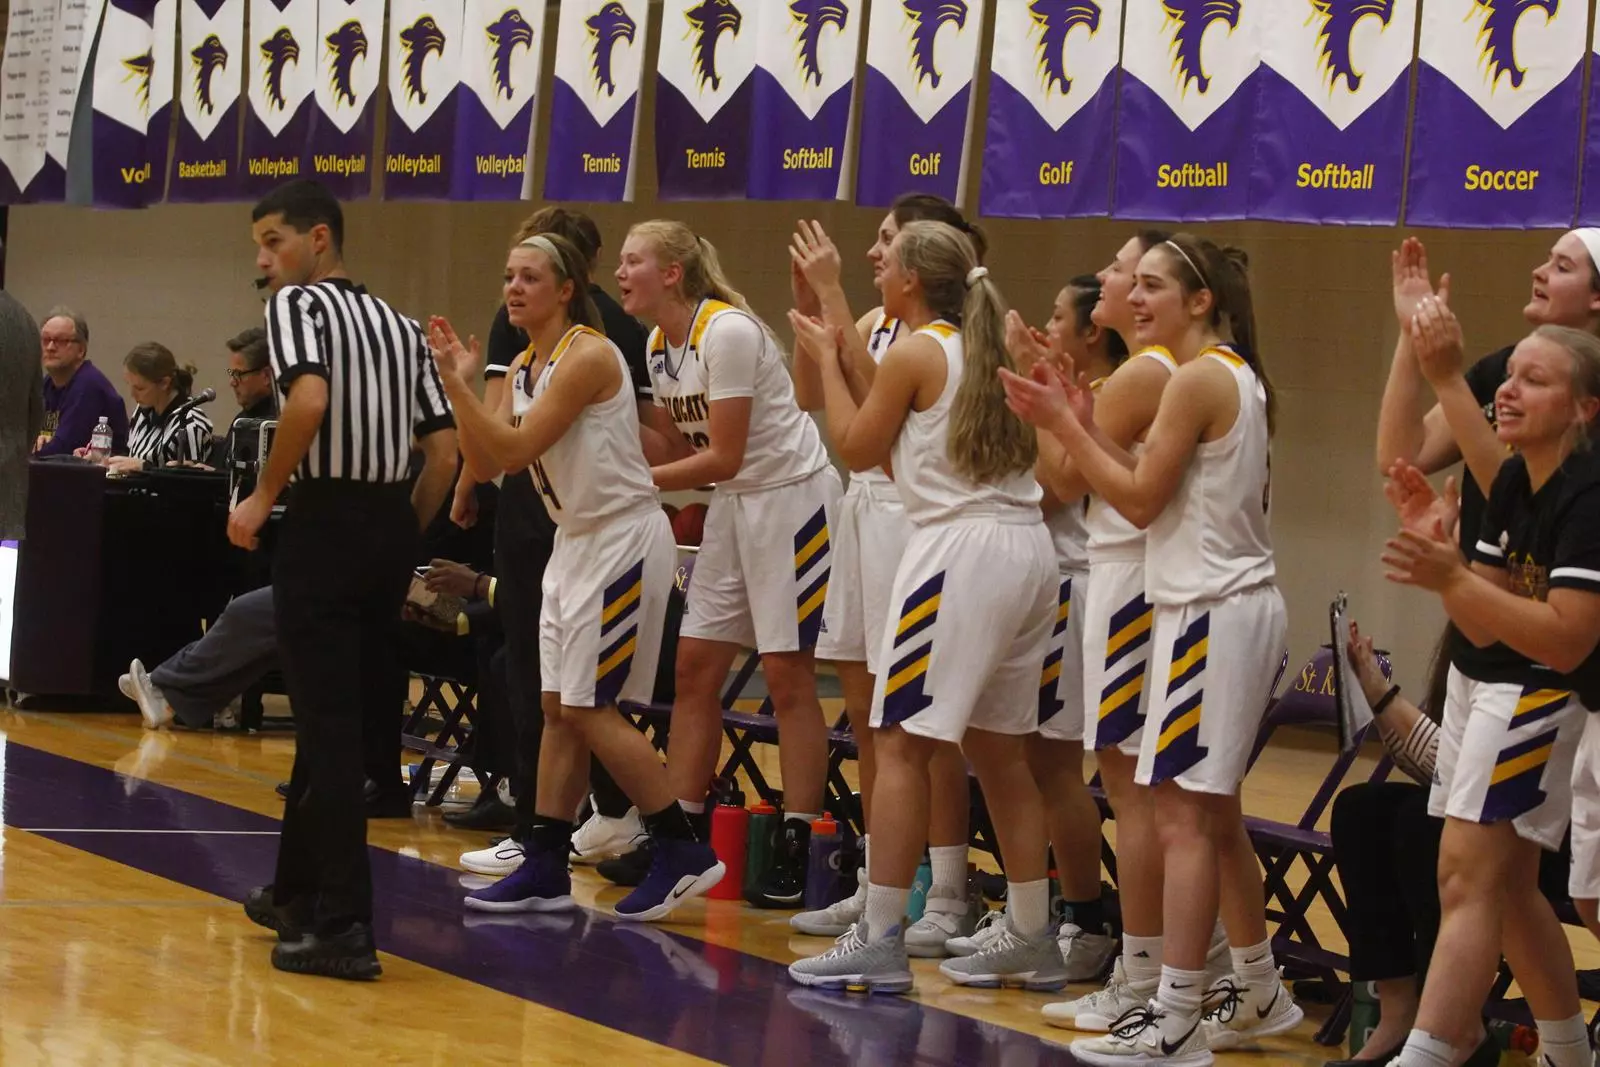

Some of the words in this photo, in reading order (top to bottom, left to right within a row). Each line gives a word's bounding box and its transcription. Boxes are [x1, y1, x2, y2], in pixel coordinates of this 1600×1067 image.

[179, 159, 227, 178] Basketball
[248, 156, 299, 178] Volleyball
[476, 153, 528, 178] Volleybal
[582, 153, 621, 173] Tennis
[686, 147, 726, 169] Tennis
[782, 147, 834, 169] Softball
[909, 153, 941, 176] Golf
[1039, 161, 1073, 185] Golf
[1156, 162, 1228, 188] Softball
[1296, 163, 1375, 189] Softball
[1464, 165, 1539, 191] Soccer
[1295, 662, 1316, 693] St.
